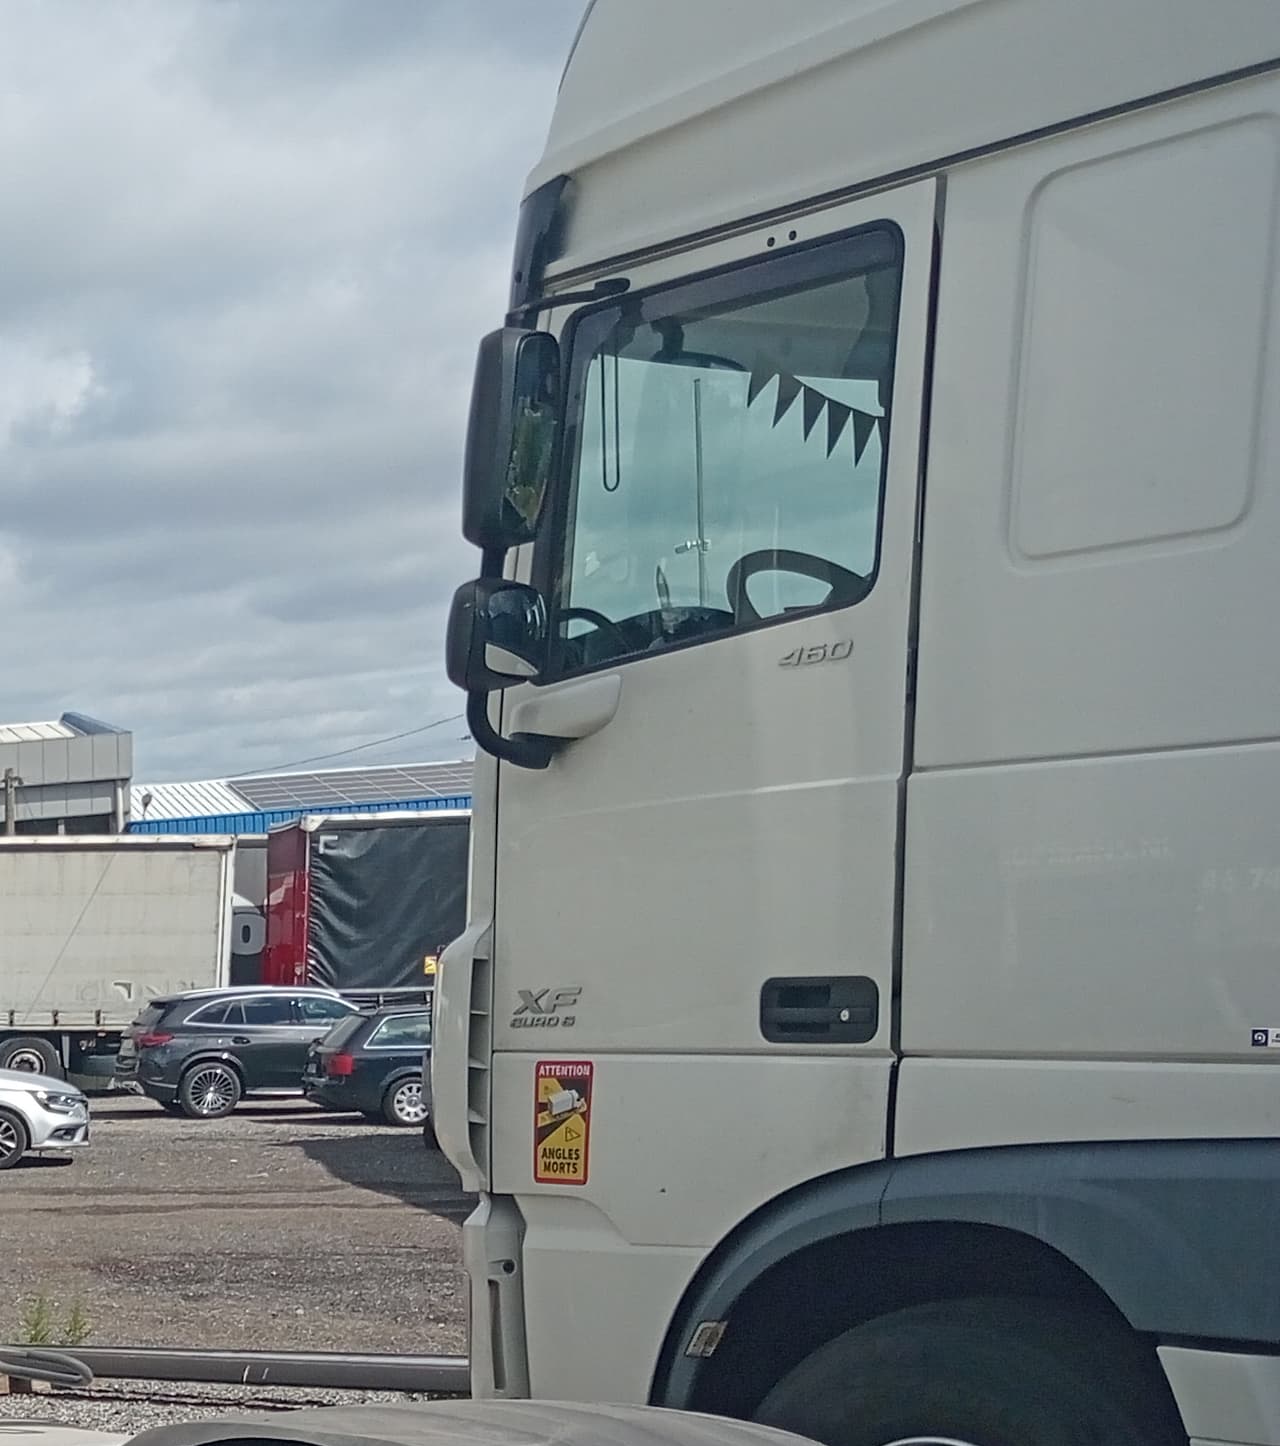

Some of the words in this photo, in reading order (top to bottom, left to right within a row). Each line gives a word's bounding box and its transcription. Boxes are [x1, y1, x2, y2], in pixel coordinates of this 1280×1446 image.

[779, 639, 854, 667] 460
[513, 987, 582, 1016] XF
[539, 1064, 591, 1077] ATTENTION
[541, 1147, 581, 1161] ANGLES
[543, 1161, 579, 1174] MORTS
